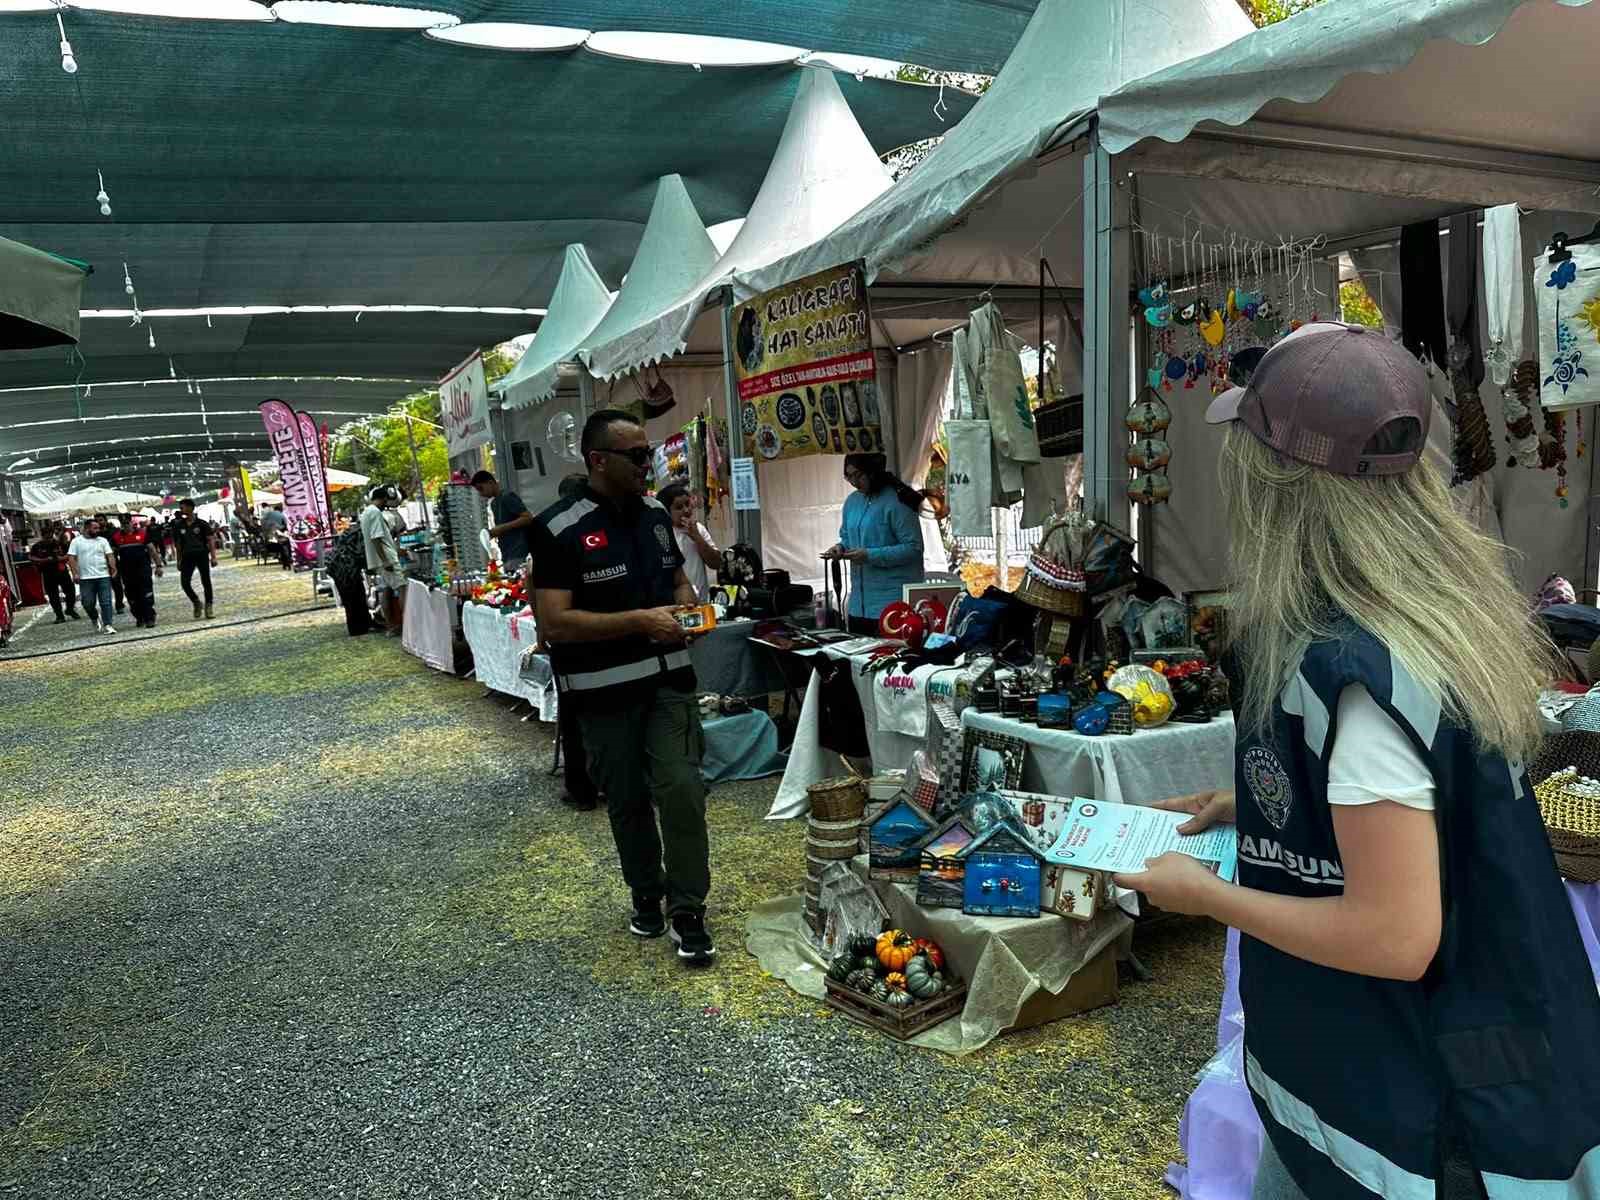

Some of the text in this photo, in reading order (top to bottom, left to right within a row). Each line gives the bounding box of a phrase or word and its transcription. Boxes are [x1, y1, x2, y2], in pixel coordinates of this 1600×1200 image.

[767, 268, 858, 324] KALİGRAFİ
[768, 330, 799, 355] HAT
[804, 309, 866, 346] SANATI
[583, 562, 628, 581] SAMSUN
[1237, 831, 1344, 878] AMSUN
